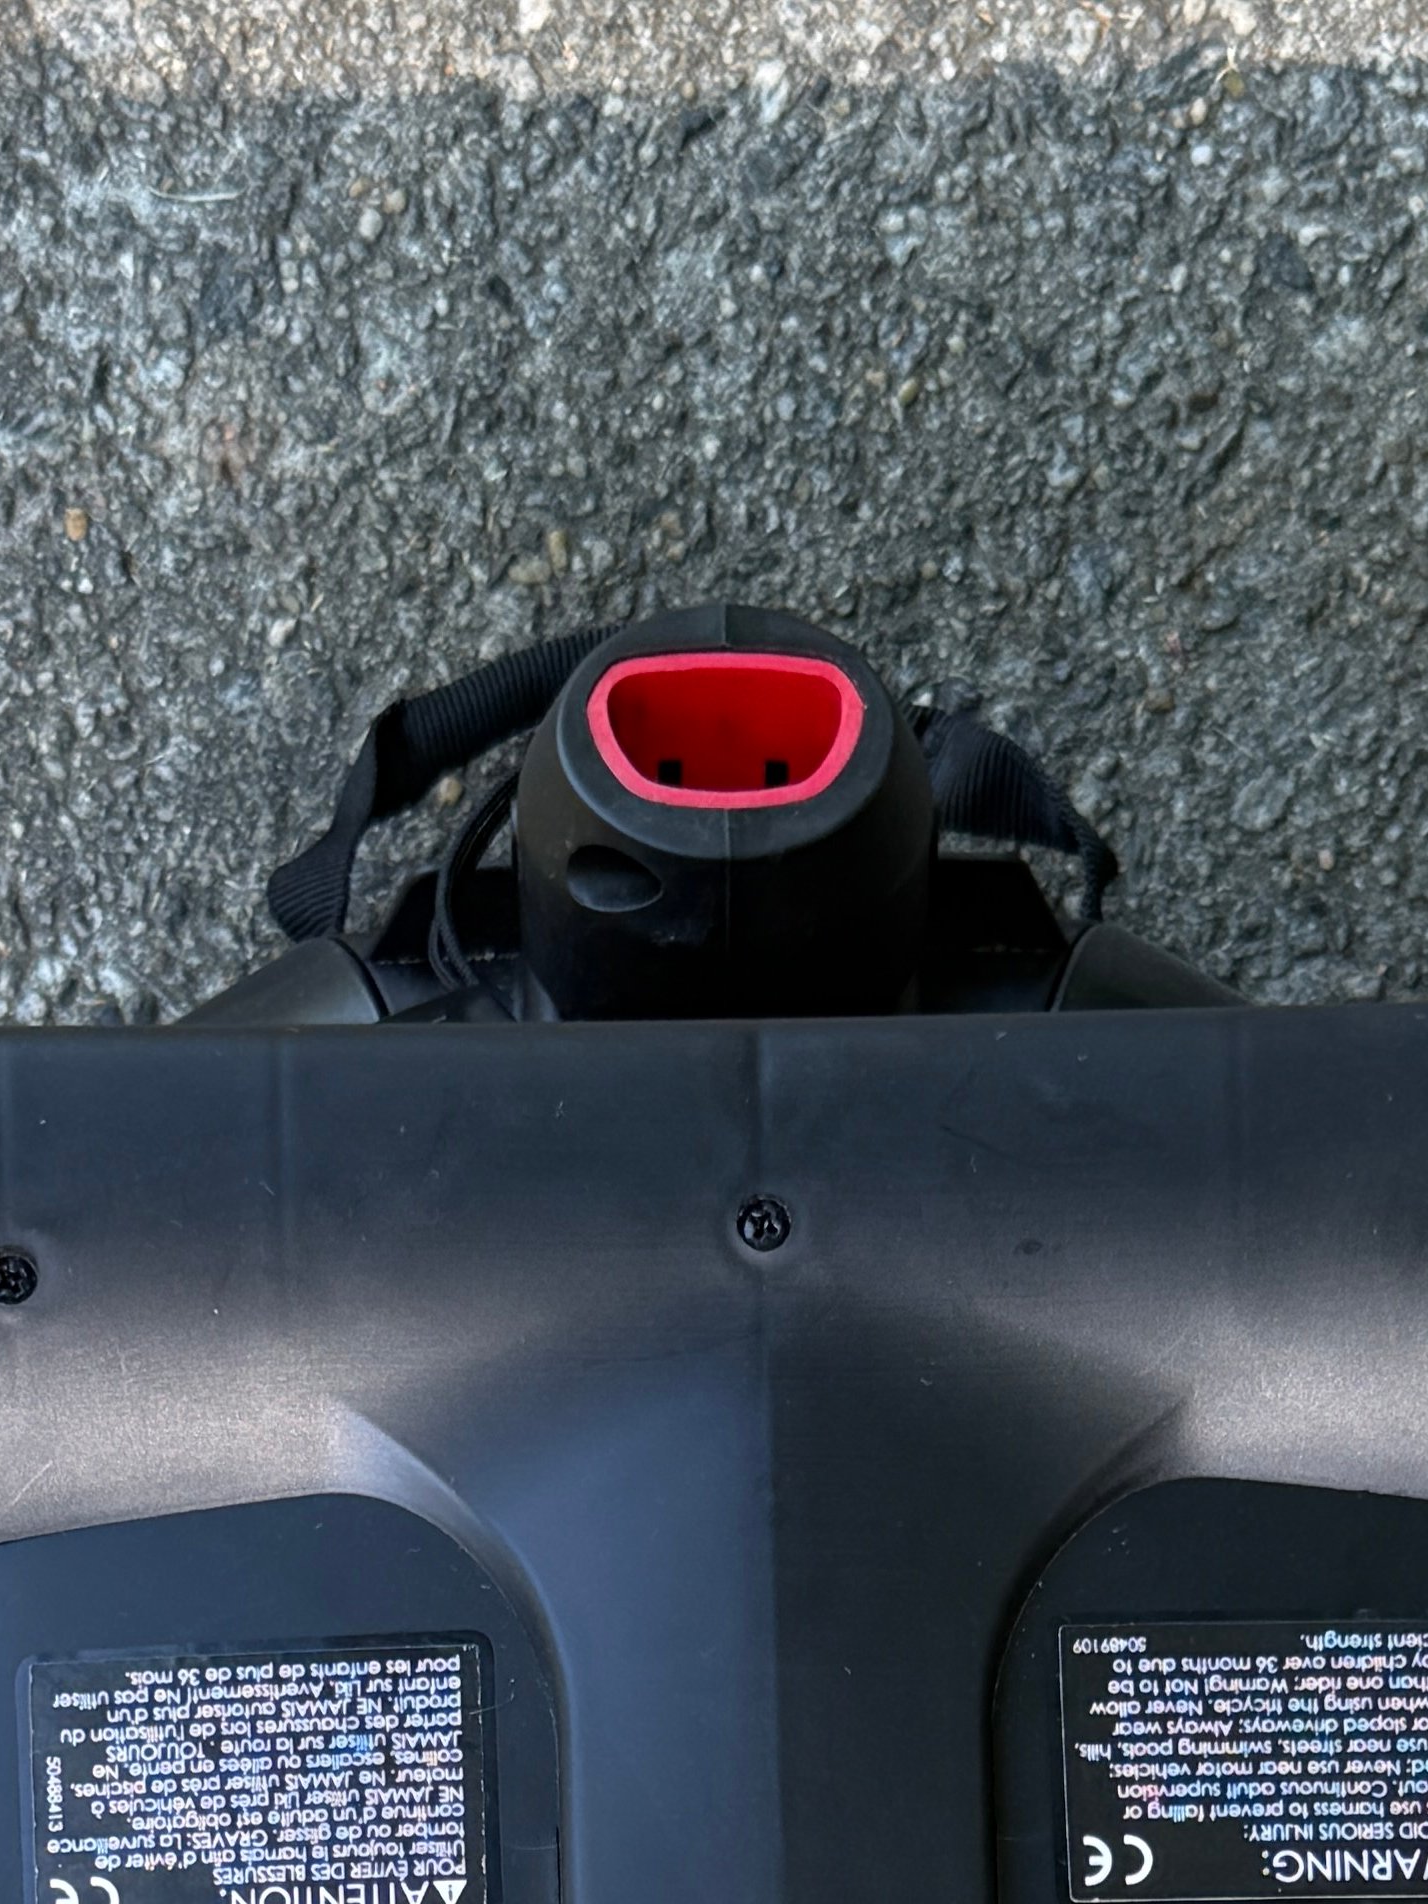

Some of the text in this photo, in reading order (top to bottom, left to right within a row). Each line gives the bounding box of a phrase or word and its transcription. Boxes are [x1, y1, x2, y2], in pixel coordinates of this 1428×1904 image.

[1072, 1636, 1147, 1653] 50489109
[1299, 1630, 1382, 1651] strength.
[124, 1653, 459, 1687] pour les enfants de plus de 36 mois.
[1112, 1657, 1132, 1674] to
[1138, 1657, 1176, 1674] due
[1181, 1656, 1251, 1673] months
[1255, 1656, 1278, 1672] 36
[1281, 1655, 1325, 1669] over
[1330, 1654, 1407, 1671] children
[365, 1678, 392, 1692] sur
[397, 1675, 460, 1694] enfant
[1107, 1679, 1134, 1696] be
[1139, 1679, 1159, 1695] to
[1164, 1678, 1198, 1695] Not
[1203, 1674, 1287, 1694] Warning!
[1346, 1676, 1383, 1690] one
[52, 1690, 109, 1709] utiliser
[113, 1685, 148, 1703] pas
[153, 1687, 180, 1705] Ne
[388, 1689, 460, 1712] produit.
[1323, 1693, 1372, 1713] using
[152, 1701, 190, 1723] plus
[195, 1701, 275, 1721] autoriser
[281, 1698, 351, 1717] JAMAIS
[356, 1696, 382, 1714] NE
[1089, 1700, 1141, 1716] allow
[1145, 1699, 1203, 1716] Never
[1207, 1695, 1282, 1715] tricycle.
[1287, 1697, 1318, 1714] the
[256, 1715, 359, 1736] chaussures
[364, 1714, 399, 1731] des
[403, 1708, 461, 1730] porter
[1112, 1720, 1162, 1734] wear
[1166, 1715, 1233, 1736] Always
[1342, 1713, 1406, 1733] sloped
[60, 1727, 85, 1745] du
[189, 1722, 216, 1739] de
[220, 1720, 250, 1738] lors
[276, 1737, 292, 1754] la
[297, 1735, 324, 1750] sur
[329, 1733, 385, 1751] utiliser
[391, 1729, 462, 1749] JAMAIS
[1177, 1737, 1272, 1758] swimming
[1347, 1739, 1391, 1752] near
[1396, 1738, 1427, 1752] use
[105, 1740, 204, 1761] TOUJOURS
[123, 1756, 185, 1778] pente.
[190, 1758, 214, 1772] en
[219, 1755, 272, 1774] allées
[277, 1754, 301, 1768] ou
[306, 1750, 384, 1770] escaliers
[1257, 1761, 1302, 1774] near
[1307, 1760, 1339, 1774] use
[1344, 1759, 1400, 1776] Never
[91, 1762, 118, 1779] Ne
[358, 1769, 385, 1787] Ne
[390, 1766, 462, 1785] moteur.
[1195, 1761, 1253, 1778] motor
[150, 1778, 176, 1796] de
[181, 1773, 220, 1794] près
[224, 1774, 279, 1792] utiliser
[284, 1771, 353, 1790] JAMAIS
[1117, 1779, 1220, 1800] supervision
[1226, 1781, 1275, 1798] adult
[1279, 1780, 1387, 1798] Continuous
[1392, 1779, 1428, 1796] out.
[45, 1755, 63, 1832] 50488413
[230, 1789, 269, 1810] près
[304, 1789, 359, 1807] utiliser
[365, 1785, 433, 1805] JAMAIS
[438, 1784, 463, 1801] NE
[90, 1800, 104, 1819] à
[108, 1796, 194, 1816] véhicules
[199, 1794, 225, 1812] de
[381, 1802, 464, 1822] continue
[1122, 1804, 1142, 1817] or
[1146, 1800, 1204, 1820] falling
[1209, 1799, 1283, 1819] prevent
[1288, 1802, 1308, 1818] to
[1313, 1801, 1384, 1818] harness
[1389, 1800, 1421, 1814] use
[126, 1809, 231, 1833] obligatoire.
[236, 1811, 262, 1828] est
[268, 1808, 328, 1827] adulte
[46, 1820, 464, 1855] tomber ou de glisser. GRAVES: La surveillance
[1243, 1823, 1313, 1840] INJURY:
[1318, 1822, 1394, 1839] SERIOUS
[240, 1845, 305, 1864] harnais
[311, 1844, 328, 1861] le
[332, 1838, 403, 1860] toujours
[411, 1838, 465, 1857] Utiliser
[94, 1853, 121, 1870] de
[200, 1848, 235, 1866] afin
[212, 1856, 465, 1883] POUR ÉVITER DES BLESSURES
